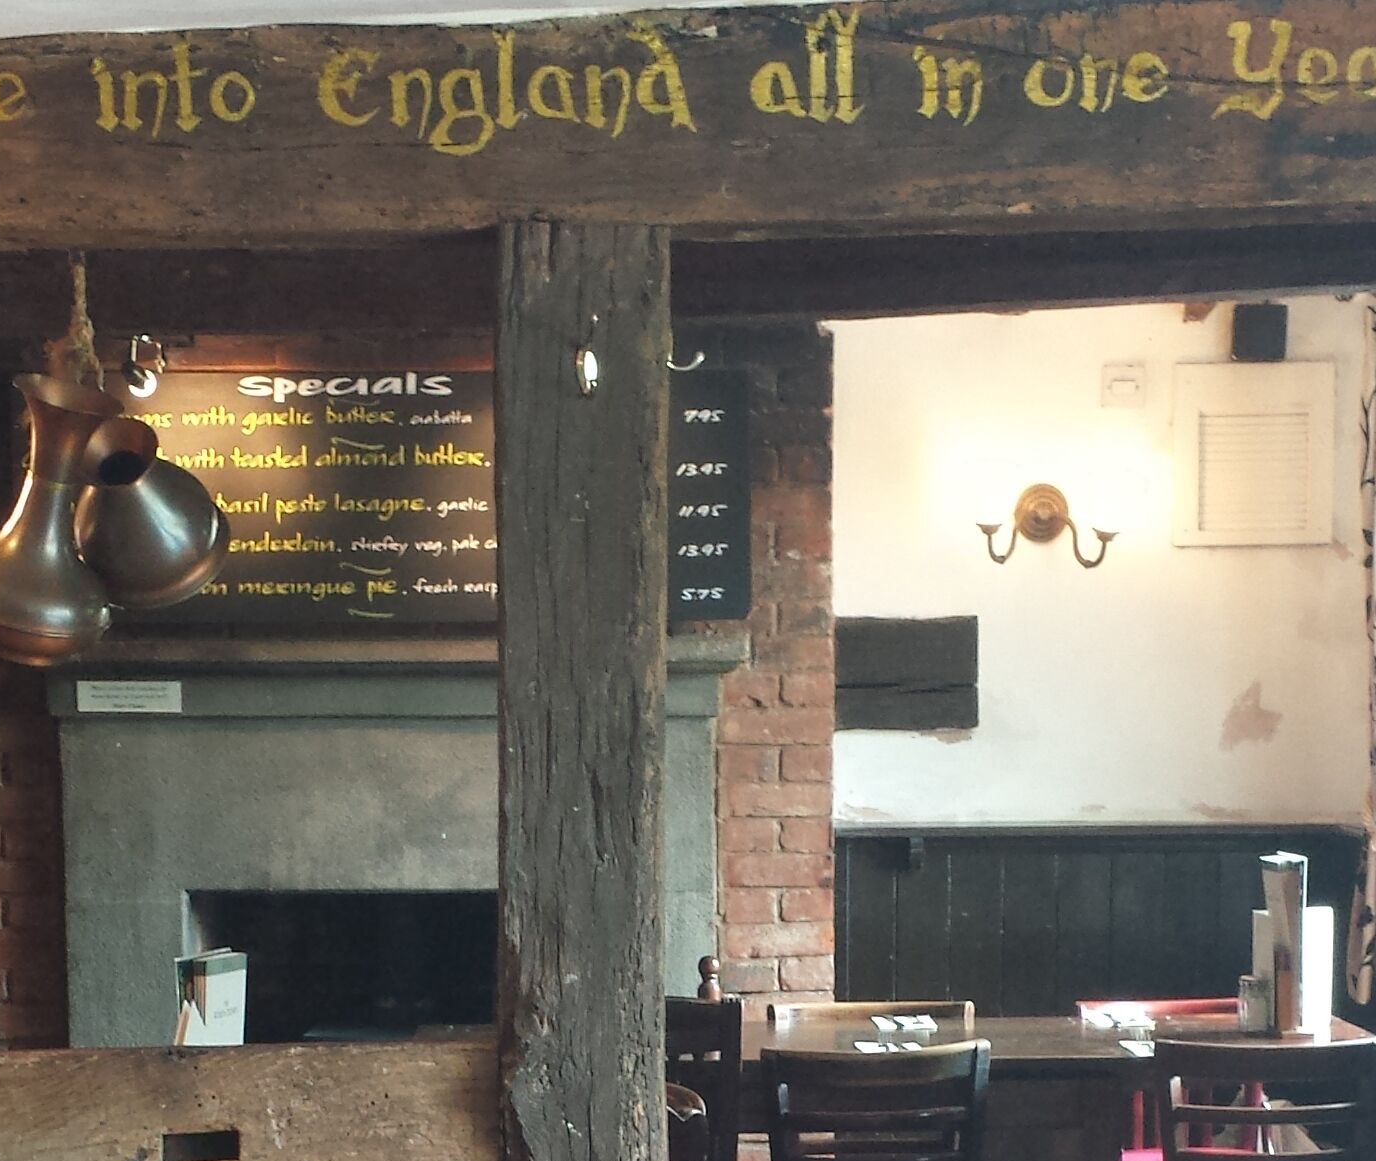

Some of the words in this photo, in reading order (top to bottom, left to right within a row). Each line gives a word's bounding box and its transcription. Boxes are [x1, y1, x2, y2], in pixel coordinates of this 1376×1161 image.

[89, 40, 256, 138] into
[317, 20, 698, 156] England
[750, 8, 865, 125] all
[913, 45, 983, 126] in
[1023, 50, 1170, 114] one
[181, 405, 236, 426] with
[174, 447, 225, 469] with
[230, 445, 308, 469] toasted
[314, 444, 405, 467] almond
[215, 491, 269, 513] basil
[275, 492, 327, 524] pesto
[228, 531, 342, 552] enderloin.
[237, 581, 357, 602] meringue
